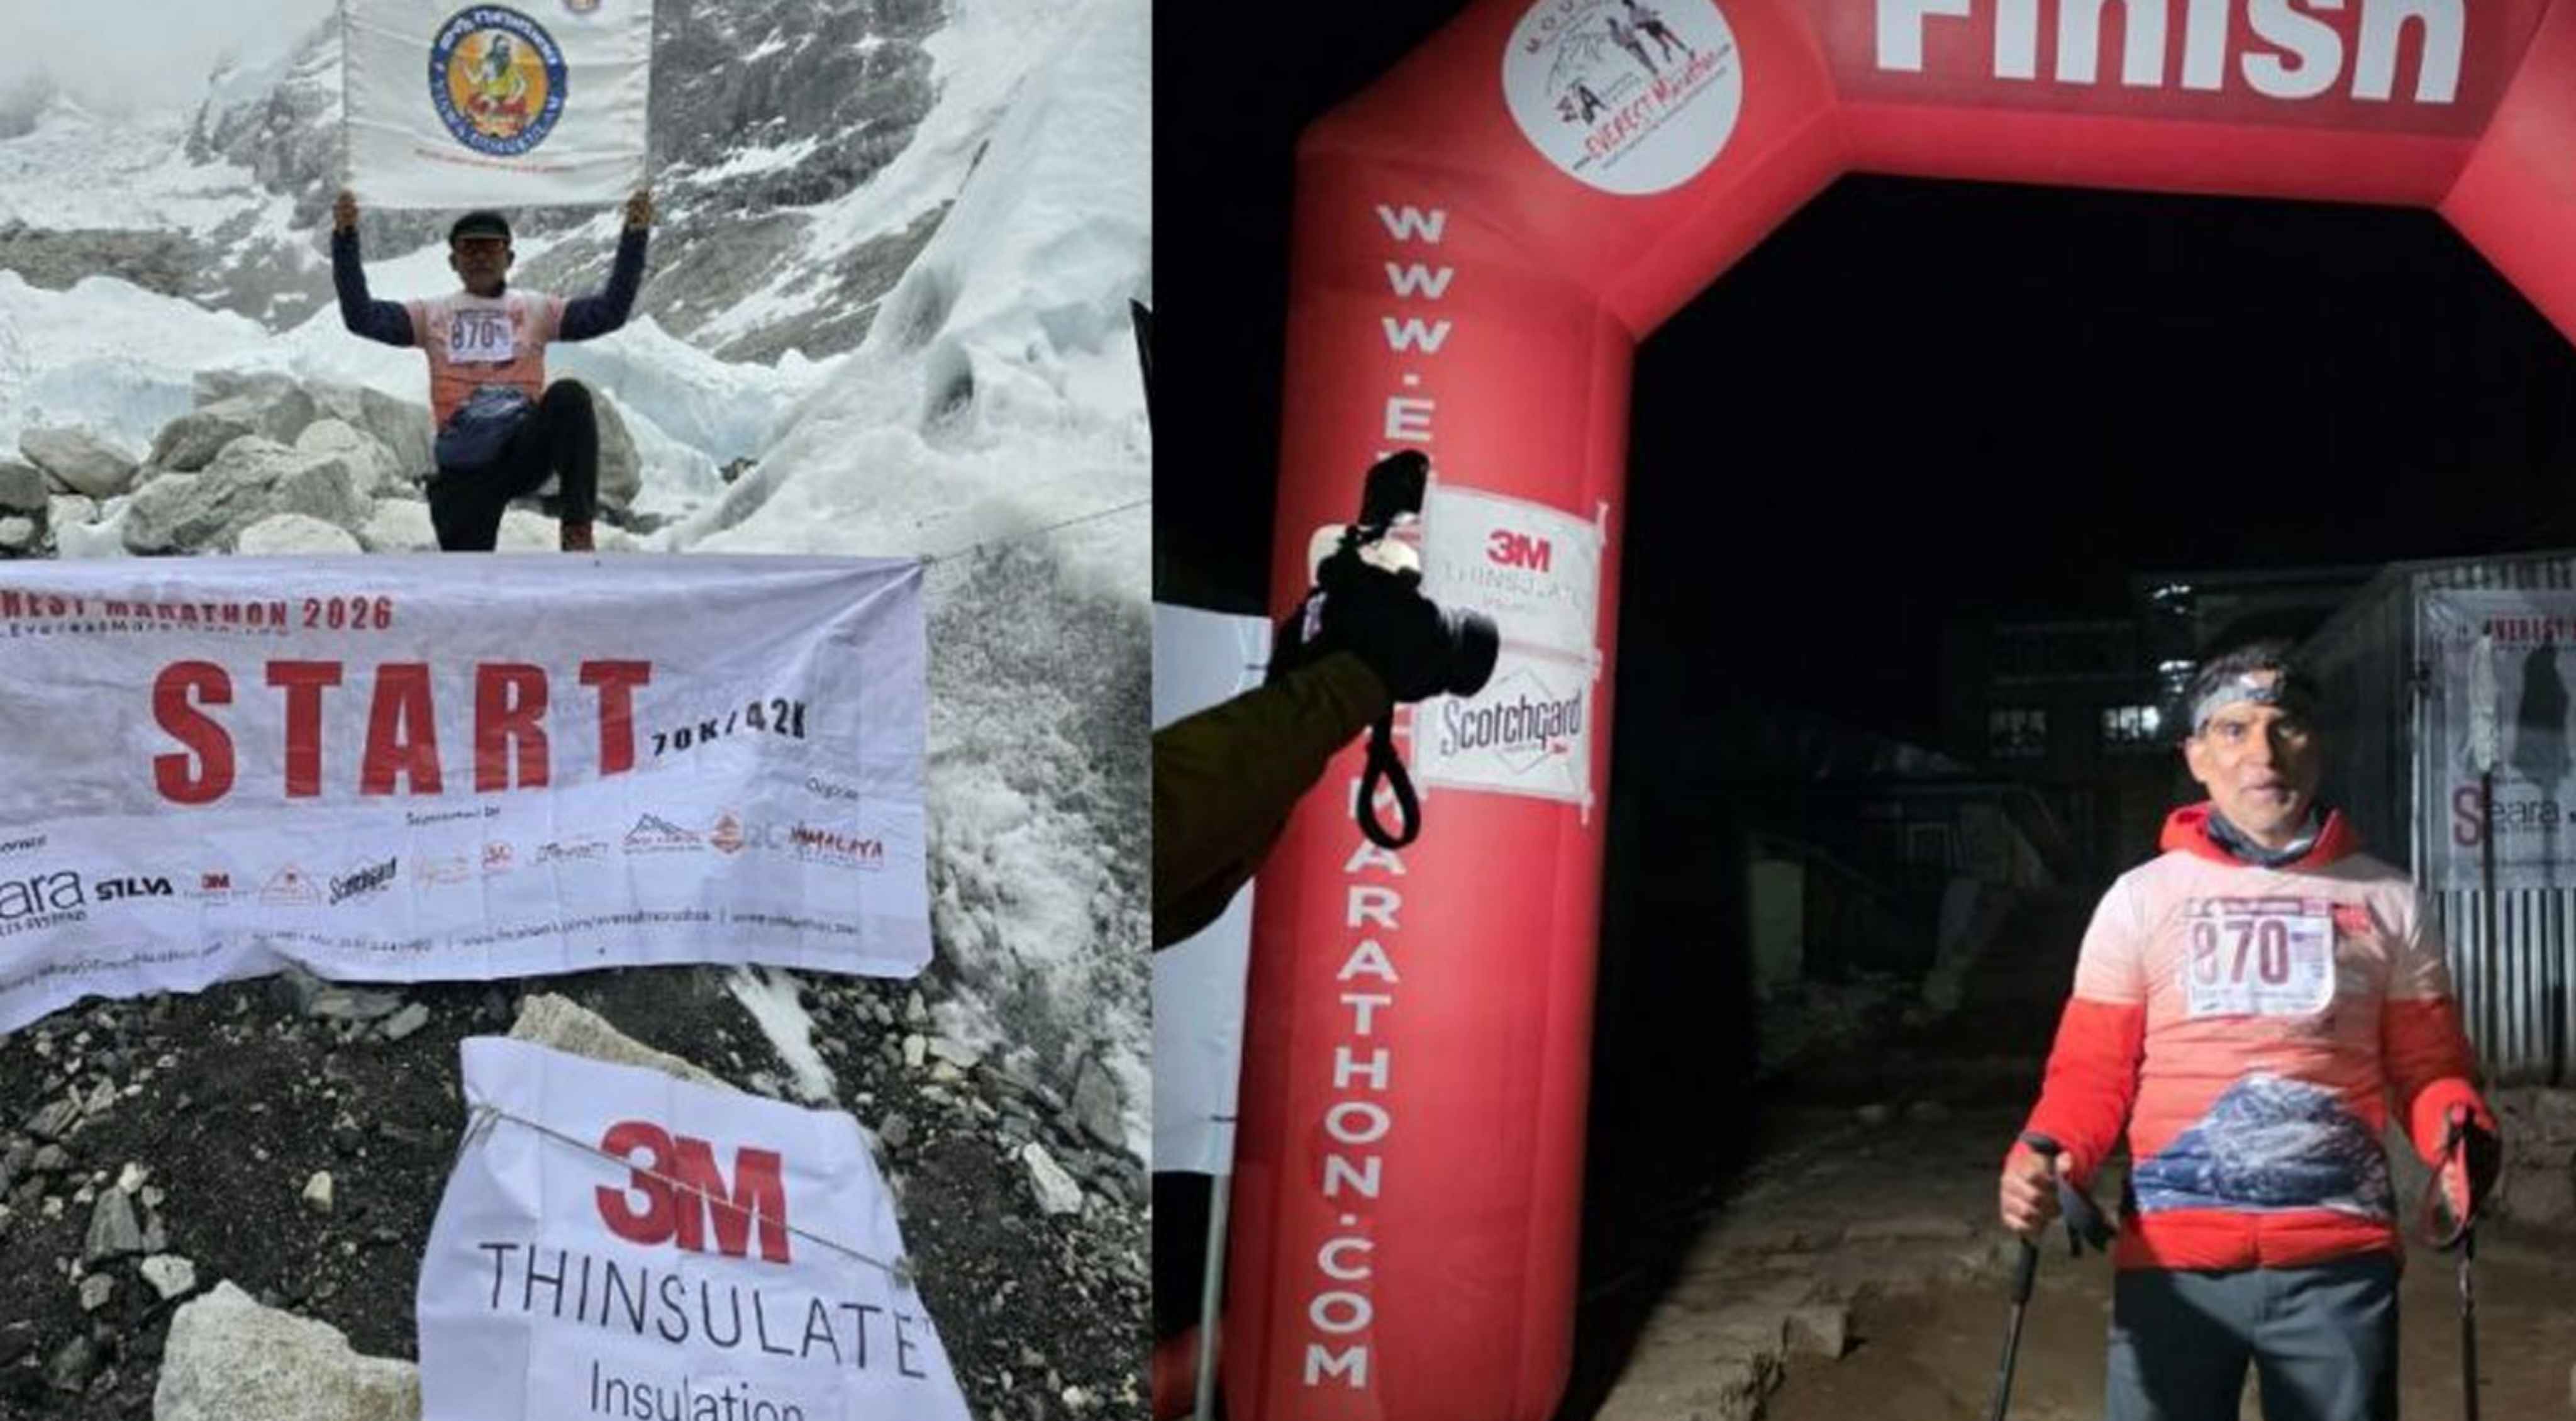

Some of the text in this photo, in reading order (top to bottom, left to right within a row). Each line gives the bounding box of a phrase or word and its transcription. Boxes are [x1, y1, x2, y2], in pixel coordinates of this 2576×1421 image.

[1877, 0, 2465, 103] Finish
[451, 319, 496, 350] 870
[1487, 529, 1552, 572] 3M
[303, 596, 394, 630] 2026
[153, 660, 653, 805] START
[1445, 683, 1583, 757] Scotchgard
[96, 877, 173, 902] SILVA
[201, 872, 231, 889] 3M
[2193, 919, 2289, 986] 870
[596, 1120, 791, 1264] 3M
[479, 1242, 928, 1379] THINSULATE
